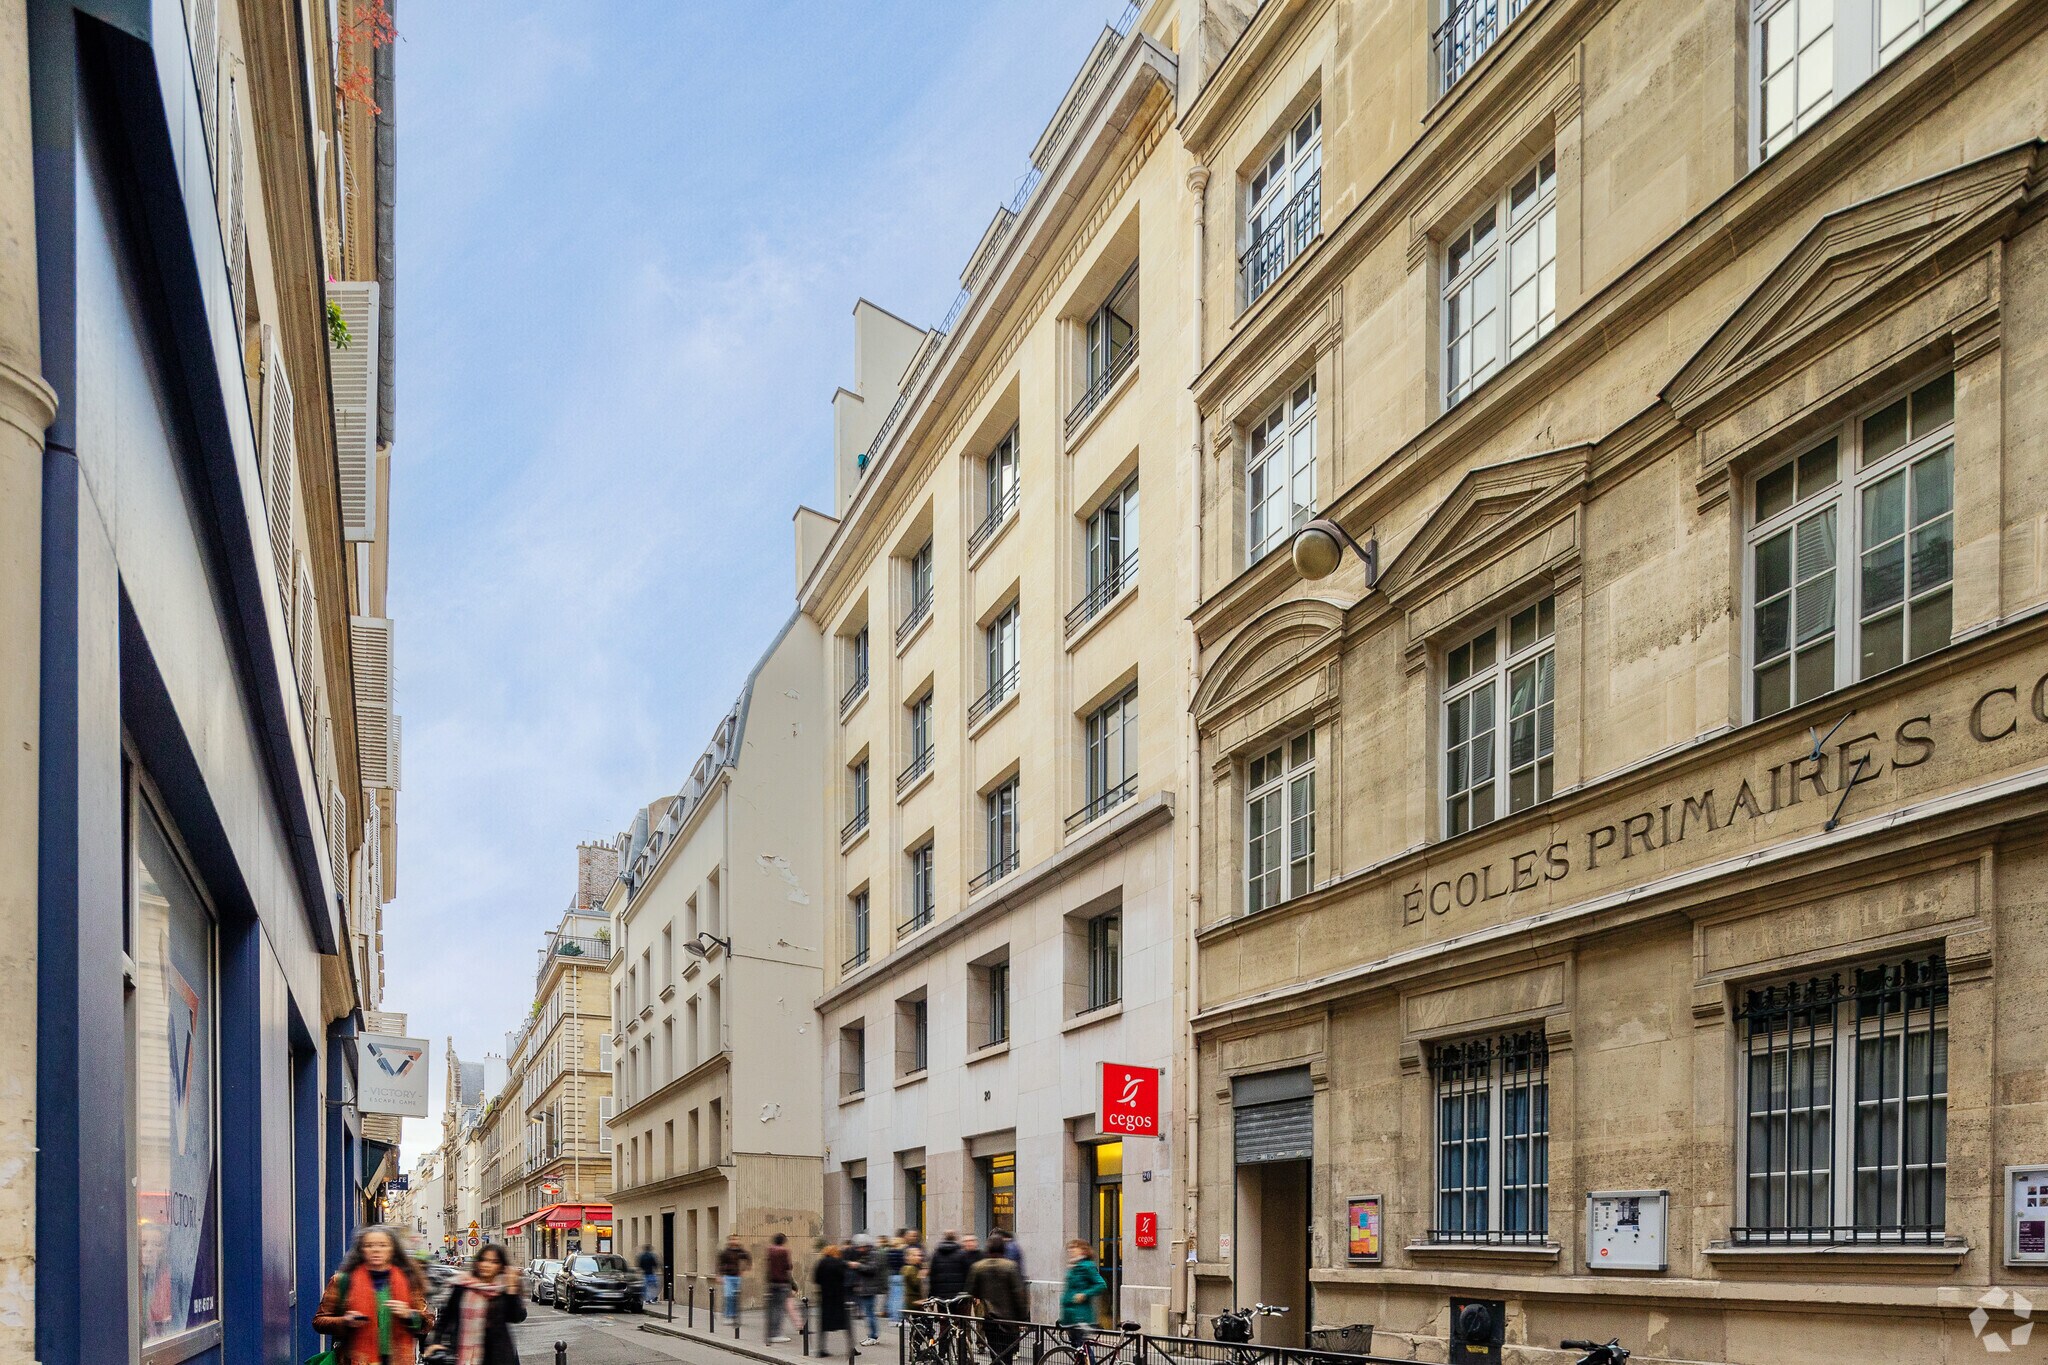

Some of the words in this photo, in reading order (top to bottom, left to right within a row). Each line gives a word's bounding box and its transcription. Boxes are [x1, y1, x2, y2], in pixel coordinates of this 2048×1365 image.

[1402, 839, 1570, 928] ÉCOLES
[1585, 713, 1936, 872] PRIMAIRES
[370, 1087, 417, 1098] VICTORY
[1109, 1113, 1152, 1131] cegos
[1143, 1171, 1151, 1180] 20
[165, 1189, 198, 1228] VICTORY
[1138, 1236, 1154, 1245] cegos
